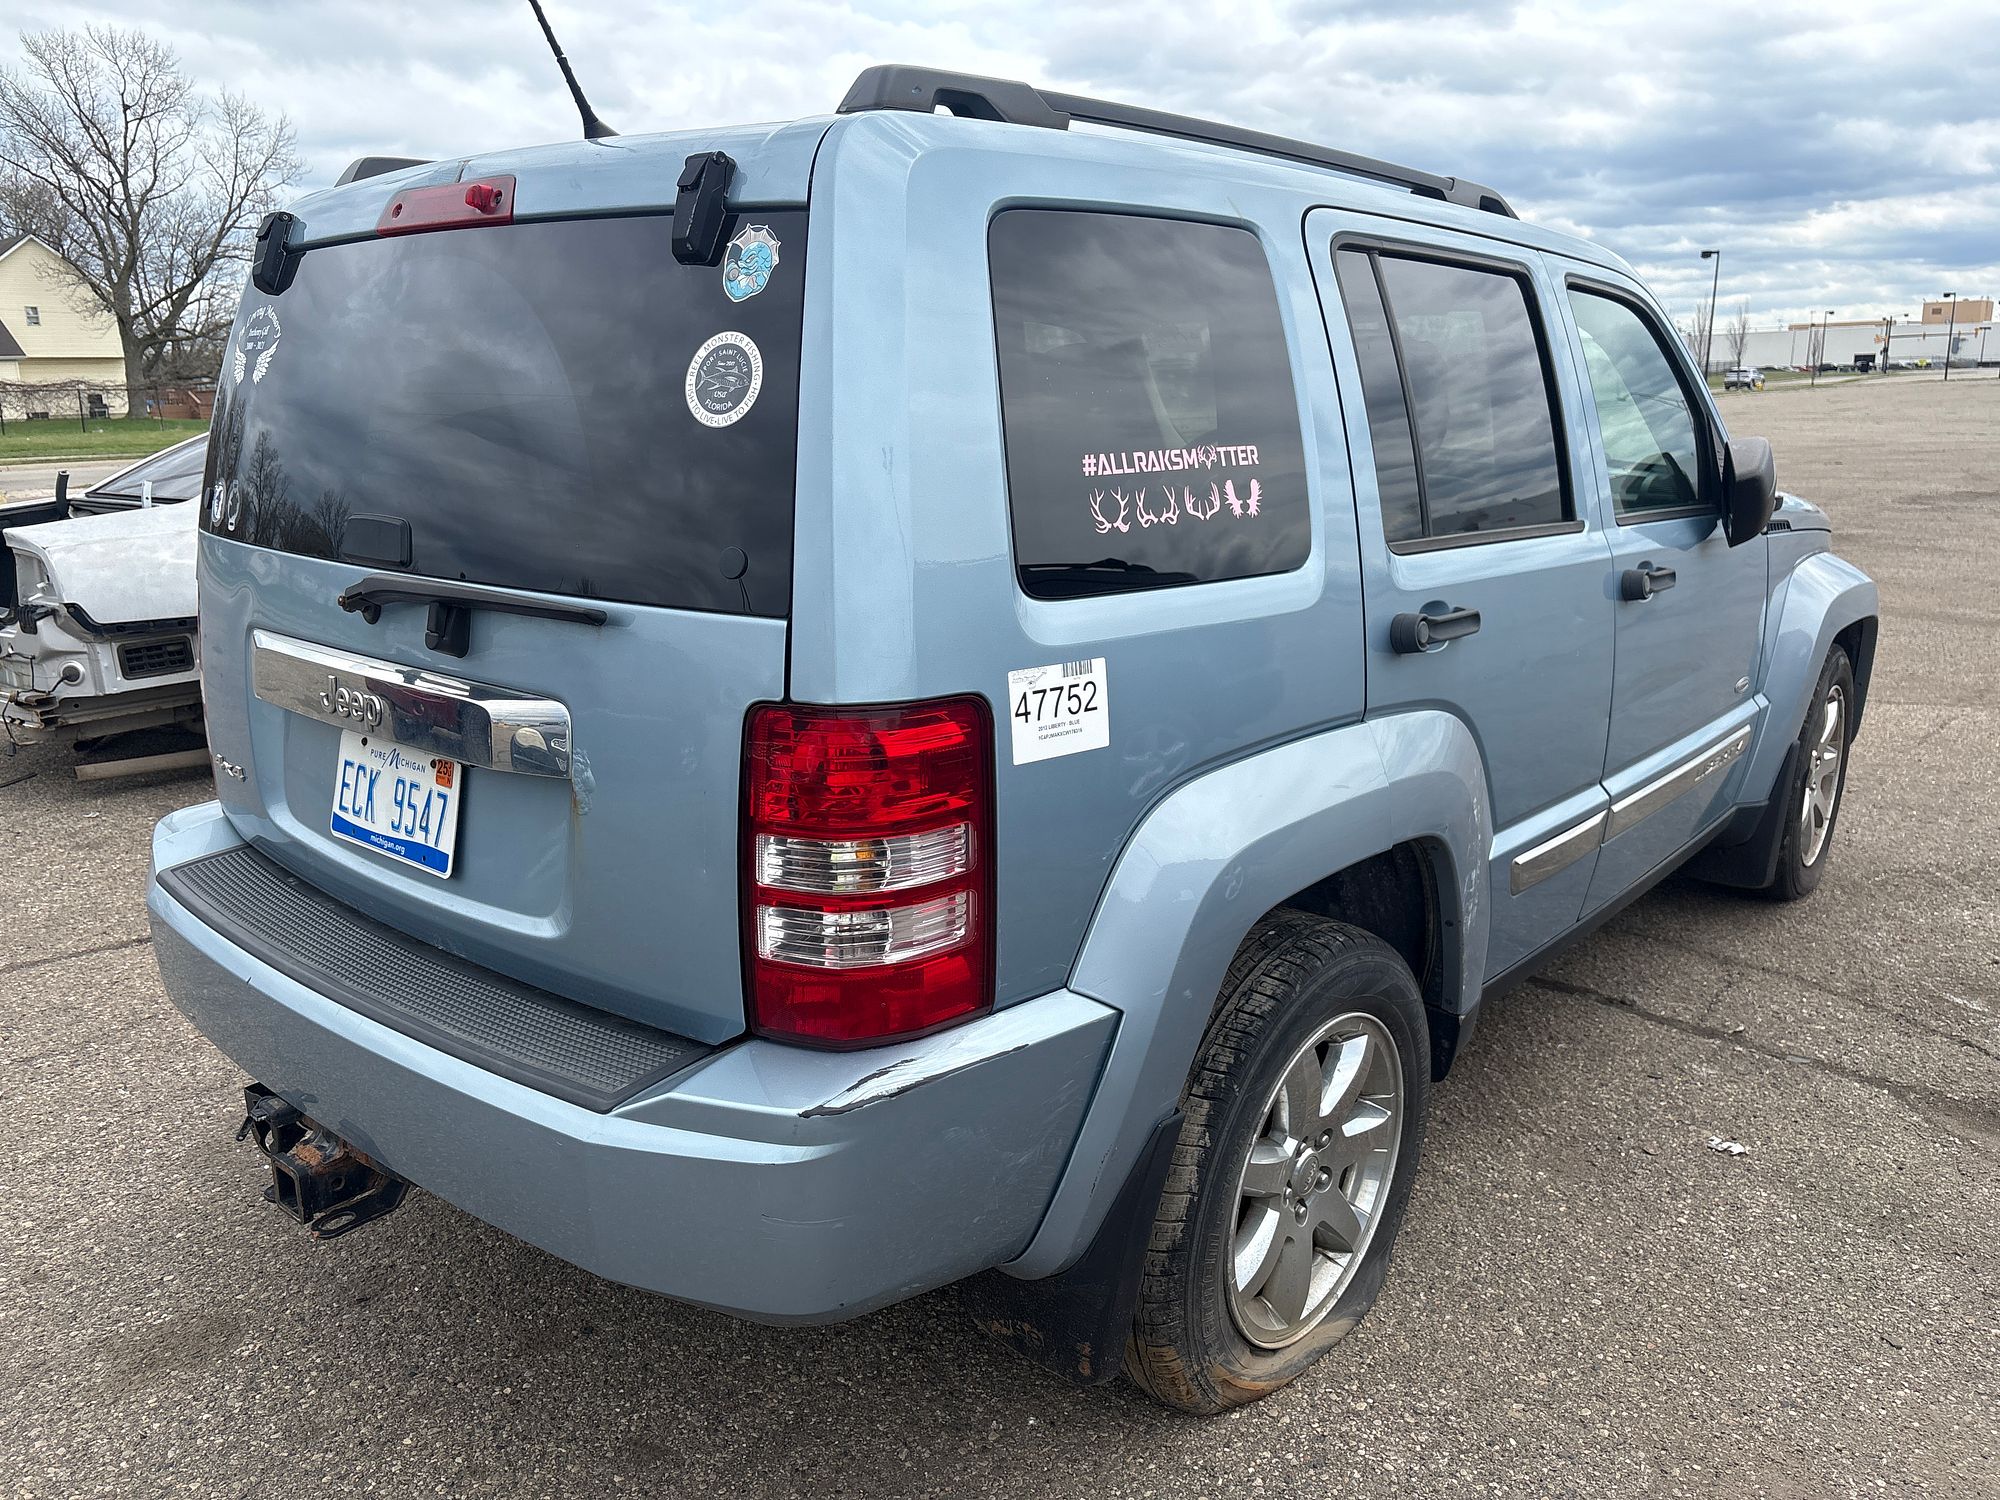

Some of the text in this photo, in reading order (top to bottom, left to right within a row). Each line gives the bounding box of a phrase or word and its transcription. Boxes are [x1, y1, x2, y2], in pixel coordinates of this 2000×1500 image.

[689, 334, 761, 381] REEL MONSTER FISHING
[703, 349, 748, 373] PORT SAINT LUCIE
[688, 384, 714, 425] FISH TO LIVE
[705, 399, 733, 411] FLORIDA
[717, 386, 758, 426] LIVE TO FISH
[320, 675, 383, 733] Jeep
[1015, 681, 1098, 723] 47752
[370, 748, 427, 773] PURE MICHIGAN
[437, 760, 449, 775] 25
[338, 758, 449, 848] ECK 9547
[370, 834, 406, 855] michigan.org
